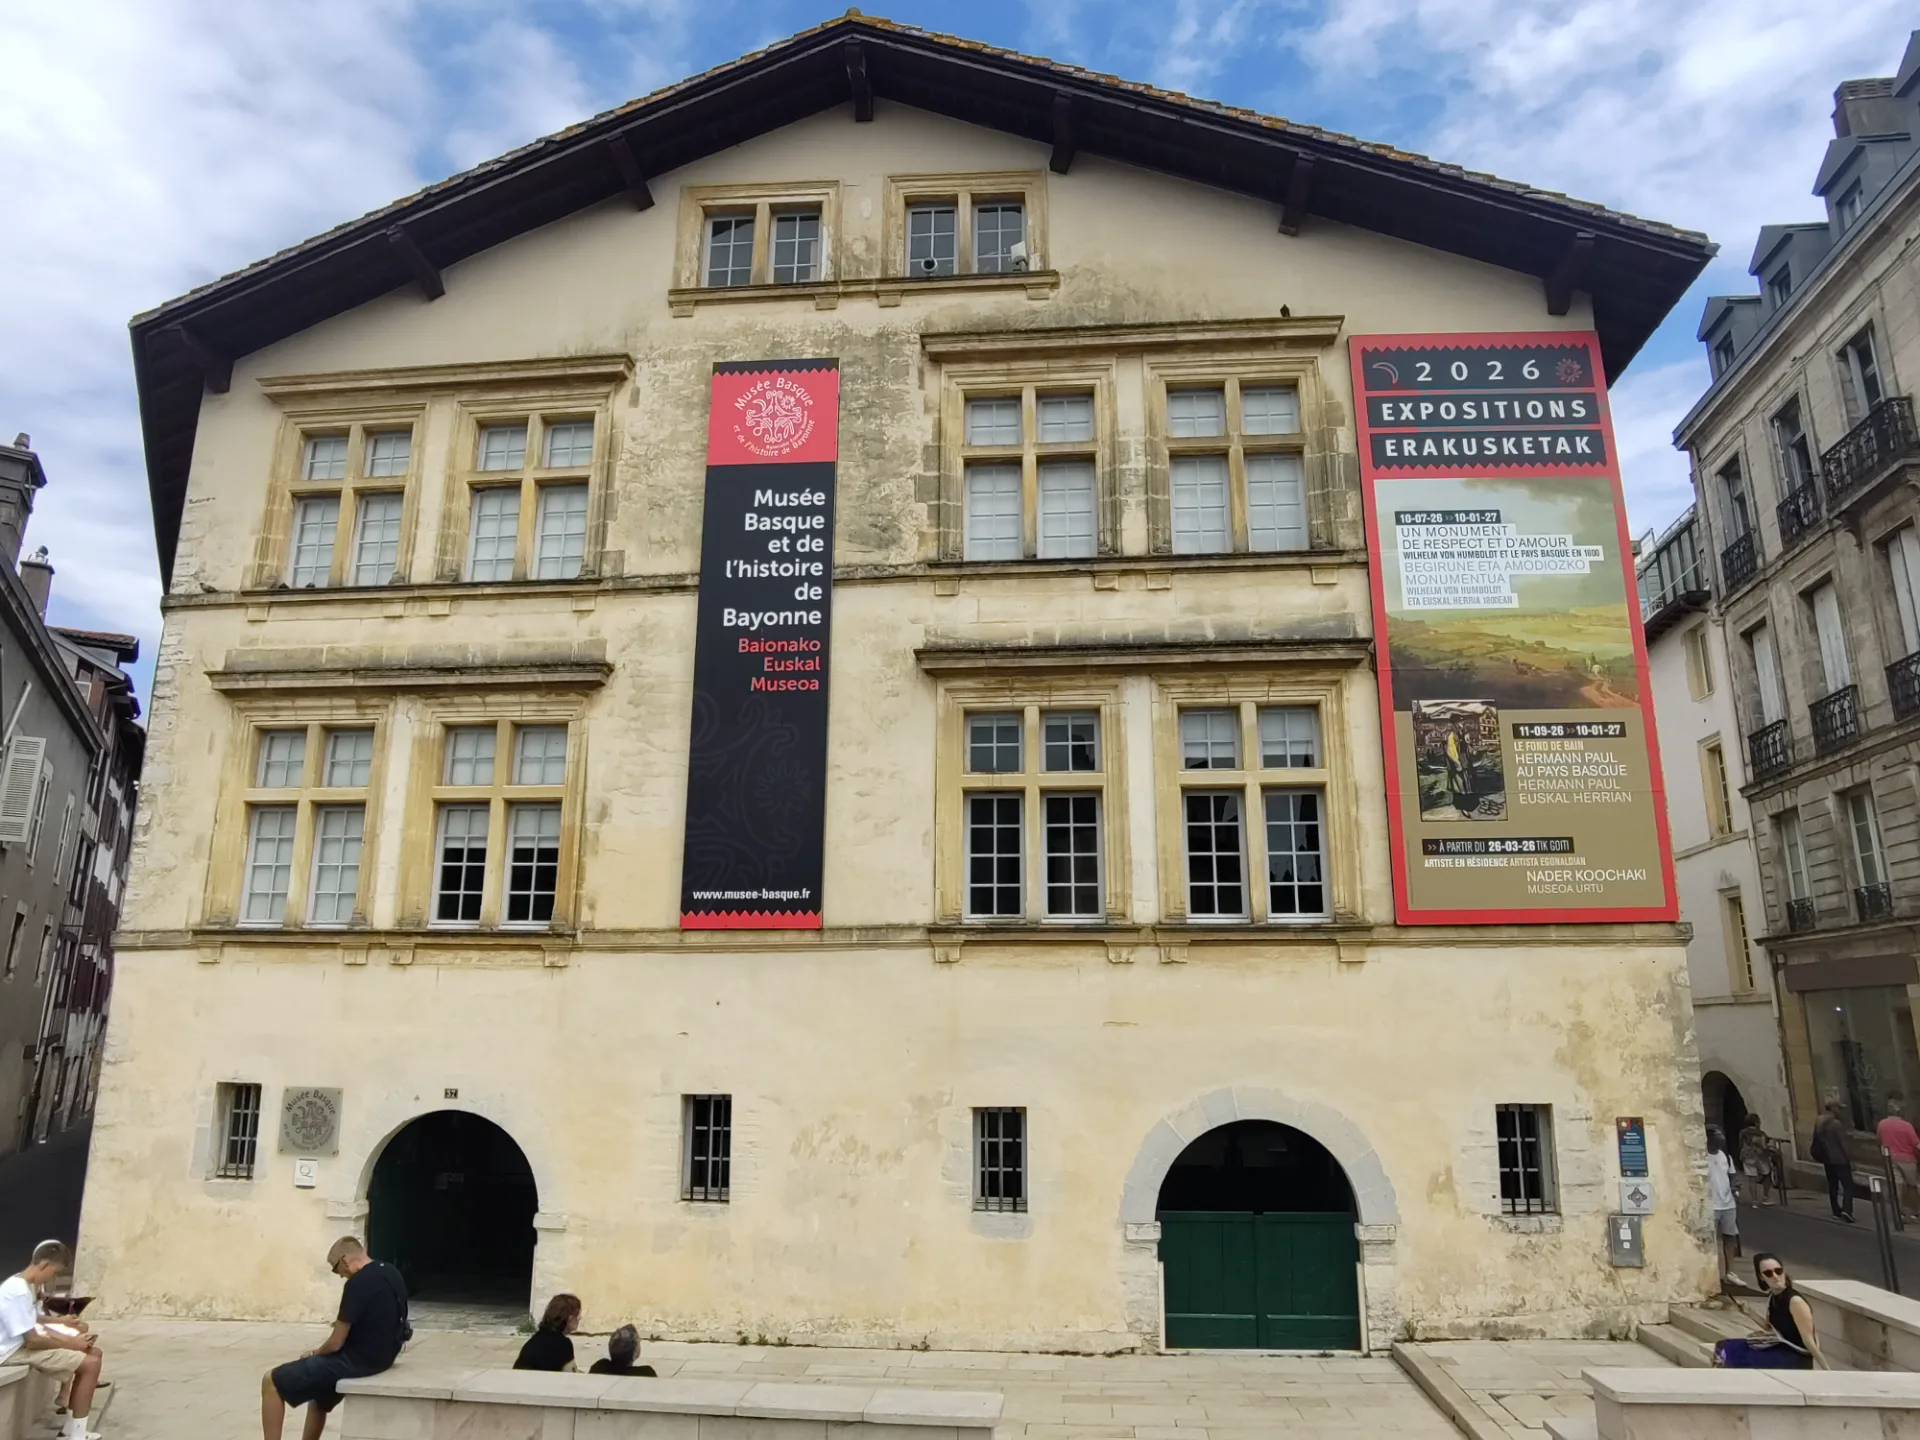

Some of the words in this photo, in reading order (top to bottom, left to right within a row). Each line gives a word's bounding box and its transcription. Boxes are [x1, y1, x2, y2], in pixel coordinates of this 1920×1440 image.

[1415, 359, 1540, 382] 2026
[776, 377, 814, 407] Basque
[1381, 400, 1587, 421] EXPOSITIONS
[1385, 436, 1592, 457] ERAKUSKETAK
[753, 489, 826, 507] Musée
[745, 513, 825, 535] Basque
[1400, 513, 1443, 523] 10-07-26
[1455, 512, 1497, 522] 10-01-27
[1401, 527, 1421, 538] UN
[1426, 525, 1508, 537] MONUMENT
[768, 536, 790, 553] et
[796, 534, 824, 552] de
[1402, 539, 1421, 550] DE
[1424, 538, 1483, 549] RESPECT
[1487, 538, 1502, 549] ET
[1506, 537, 1568, 548] D'AMOUR
[1403, 551, 1438, 560] WILHELM
[1440, 551, 1455, 559] VON
[1457, 550, 1498, 559] HUMBOLDT
[1500, 550, 1508, 558] ET
[1511, 550, 1519, 558] LE
[1521, 549, 1539, 558] PAYS
[1541, 549, 1569, 558] BASQUE
[1571, 549, 1582, 557] EN
[725, 560, 823, 578] l'histoire
[1405, 561, 1475, 572] BEGIRUNE
[1478, 561, 1500, 571] ETA
[1504, 560, 1586, 571] AMODIOZKO
[1406, 574, 1505, 585] MONUMENTUA
[794, 583, 822, 600] de
[1407, 586, 1442, 595] WILHELM
[1407, 597, 1421, 606] ETA
[1422, 597, 1450, 605] EUSKAL
[723, 608, 822, 630] Bayonne
[738, 637, 821, 653] Baionako
[763, 656, 820, 672] Euskal
[750, 676, 819, 692] Museoa
[1519, 726, 1564, 736] 11-09-26
[1576, 725, 1620, 735] 10-01-27
[1514, 742, 1524, 751] LE
[1526, 741, 1549, 751] FOND
[1551, 741, 1562, 750] DE
[1564, 741, 1584, 750] BAIN
[1515, 752, 1582, 764] HERMANN
[1585, 752, 1618, 763] PAUL
[1517, 766, 1534, 777] AU
[1537, 765, 1569, 776] PAYS
[1572, 765, 1628, 777] BASQUE
[1518, 779, 1585, 791] HERMANN
[1588, 779, 1621, 790] PAUL
[1520, 793, 1570, 804] EUSKAL
[1573, 792, 1632, 803] HERRIAN
[1446, 842, 1473, 852] PARTIR
[1475, 841, 1486, 852] DU
[1488, 841, 1536, 852] 26-03-26
[1537, 840, 1548, 850] TIK
[1424, 858, 1453, 868] ARTISTE
[1455, 859, 1465, 867] EN
[1466, 857, 1509, 867] RÉSIDENCE
[1510, 858, 1539, 867] ARTISTA
[1526, 870, 1573, 882] NADER
[1575, 869, 1647, 881] KOOCHAKI
[692, 888, 811, 901] www.musee-basque.fr
[1527, 884, 1575, 894] MUSEOA
[1576, 884, 1604, 893] URTU
